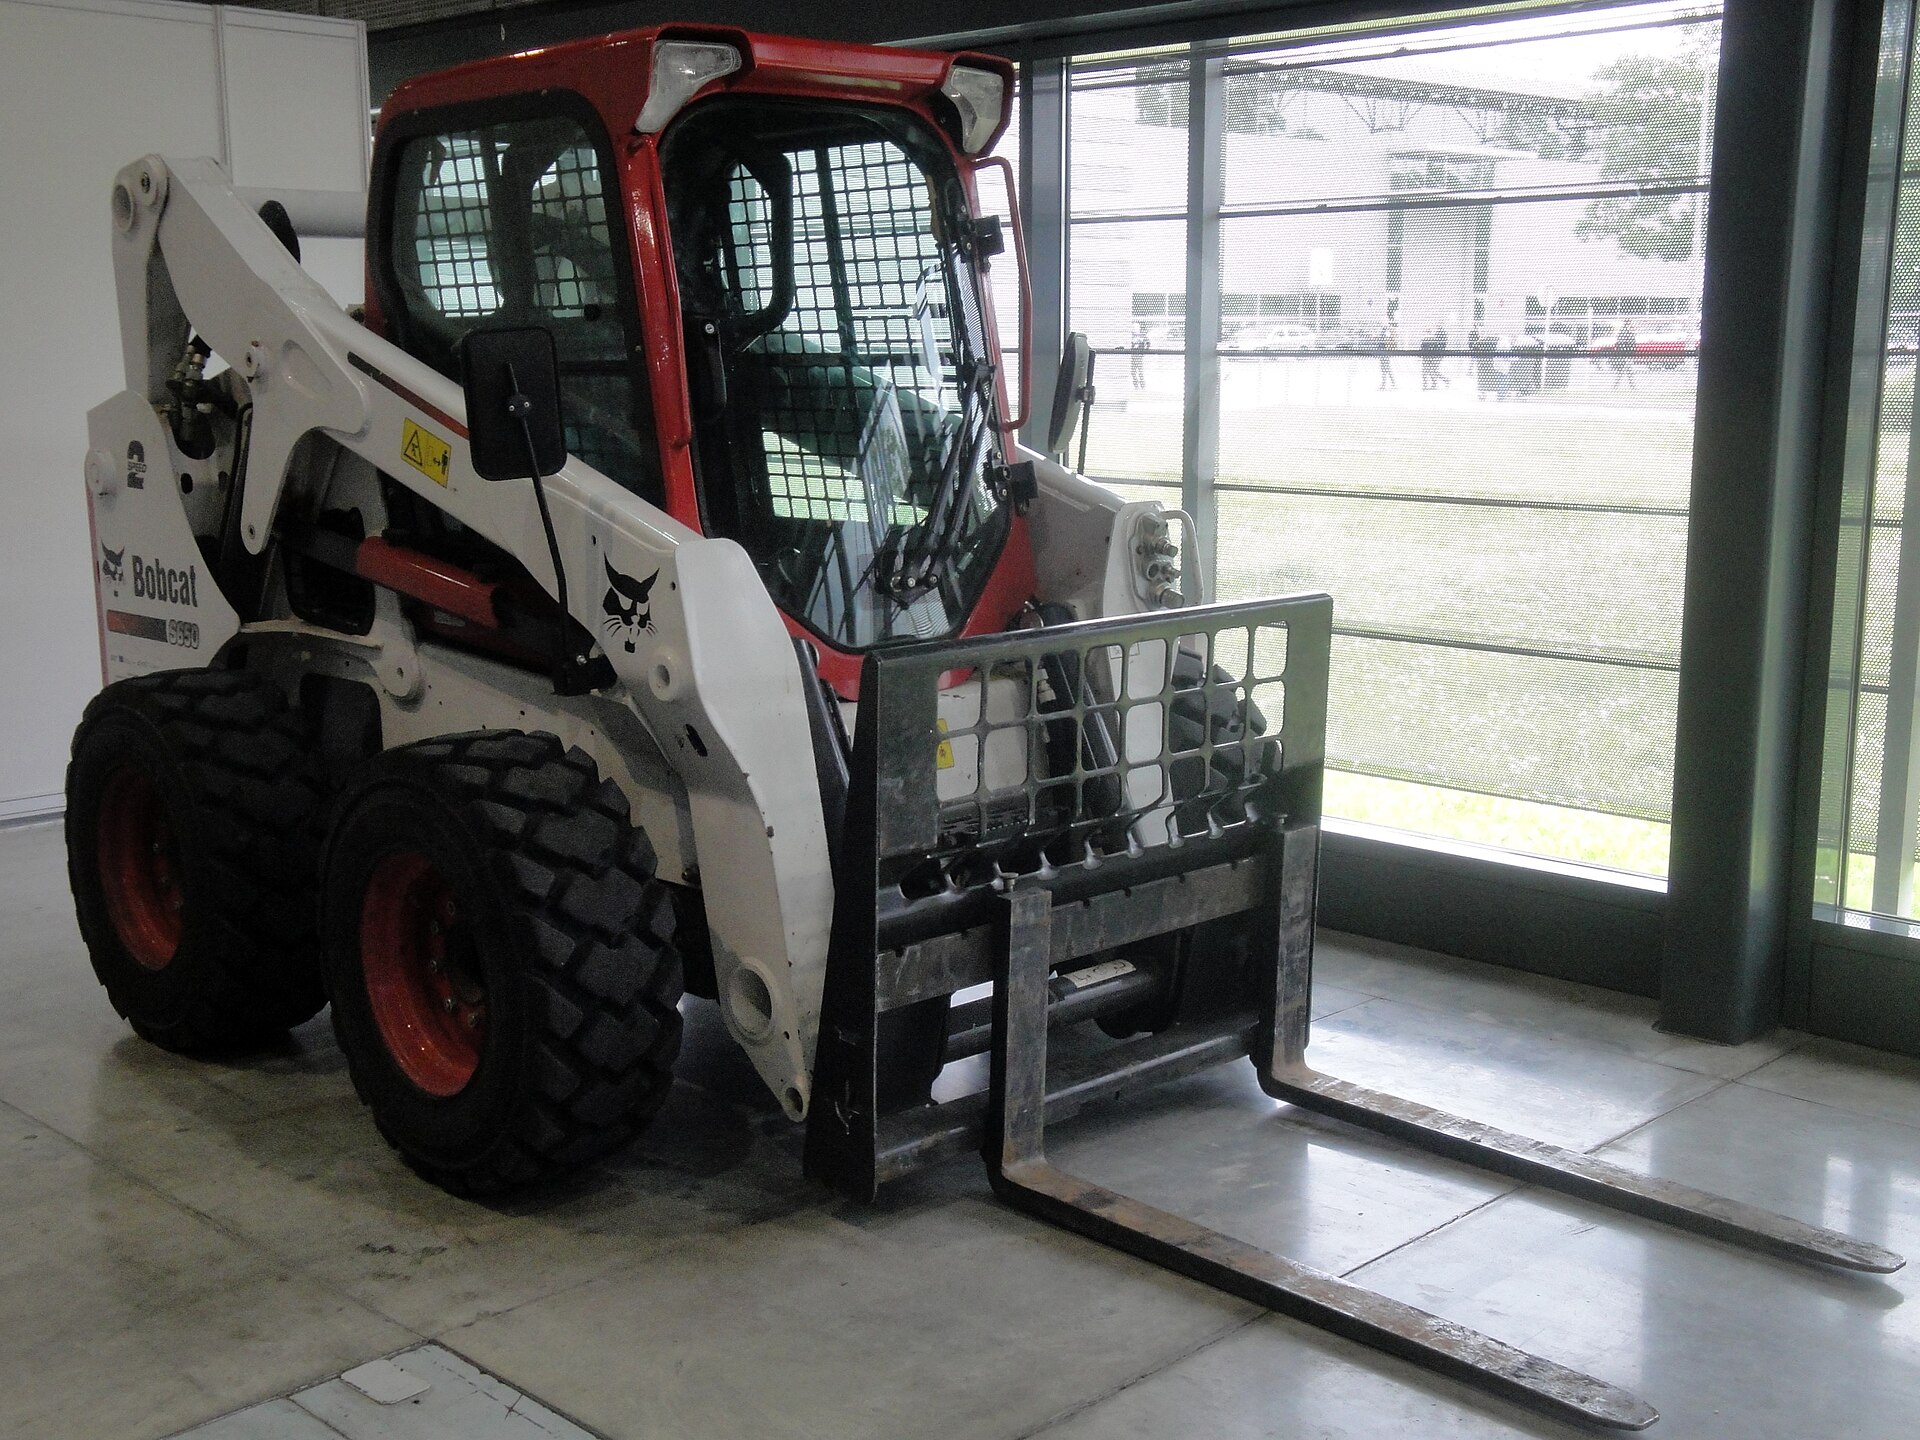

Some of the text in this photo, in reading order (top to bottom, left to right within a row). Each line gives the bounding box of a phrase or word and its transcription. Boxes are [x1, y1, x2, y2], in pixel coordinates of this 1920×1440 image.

[127, 461, 147, 473] SPEED
[132, 555, 198, 608] Bobcat
[168, 619, 200, 650] S650
